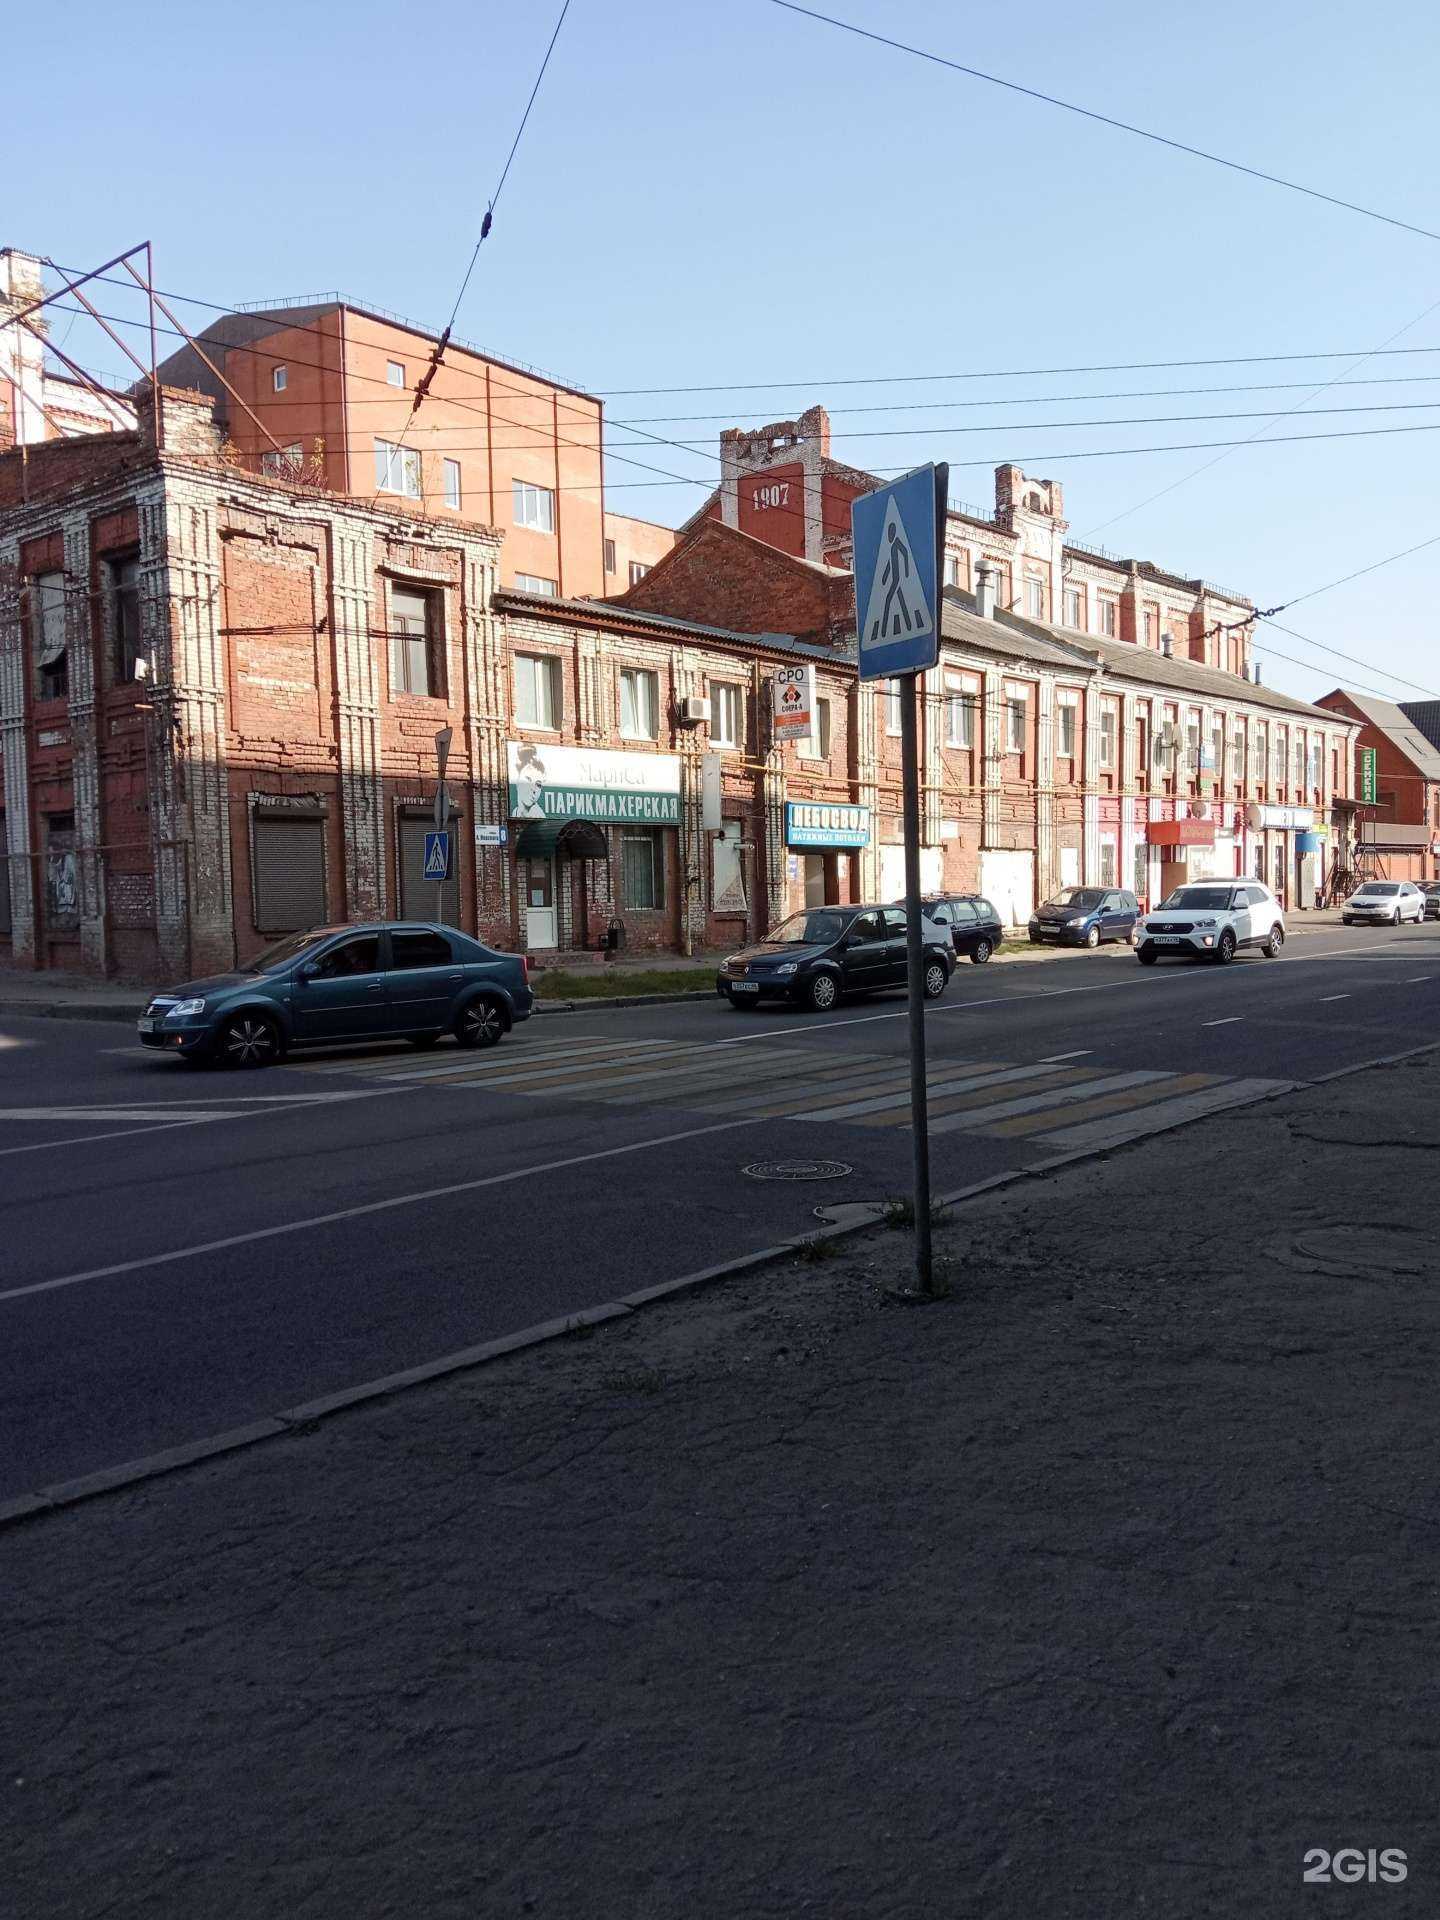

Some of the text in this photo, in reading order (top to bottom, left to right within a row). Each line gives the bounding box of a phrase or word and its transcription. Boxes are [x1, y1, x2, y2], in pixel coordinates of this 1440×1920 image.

[752, 483, 789, 511] 1907
[778, 668, 804, 684] СРО
[1363, 755, 1372, 801] СЕМЕНА
[544, 791, 678, 819] ПАРИКМАХЕРСКАЯ
[791, 806, 869, 831] НЕБОСВОД
[500, 829, 507, 842] 8
